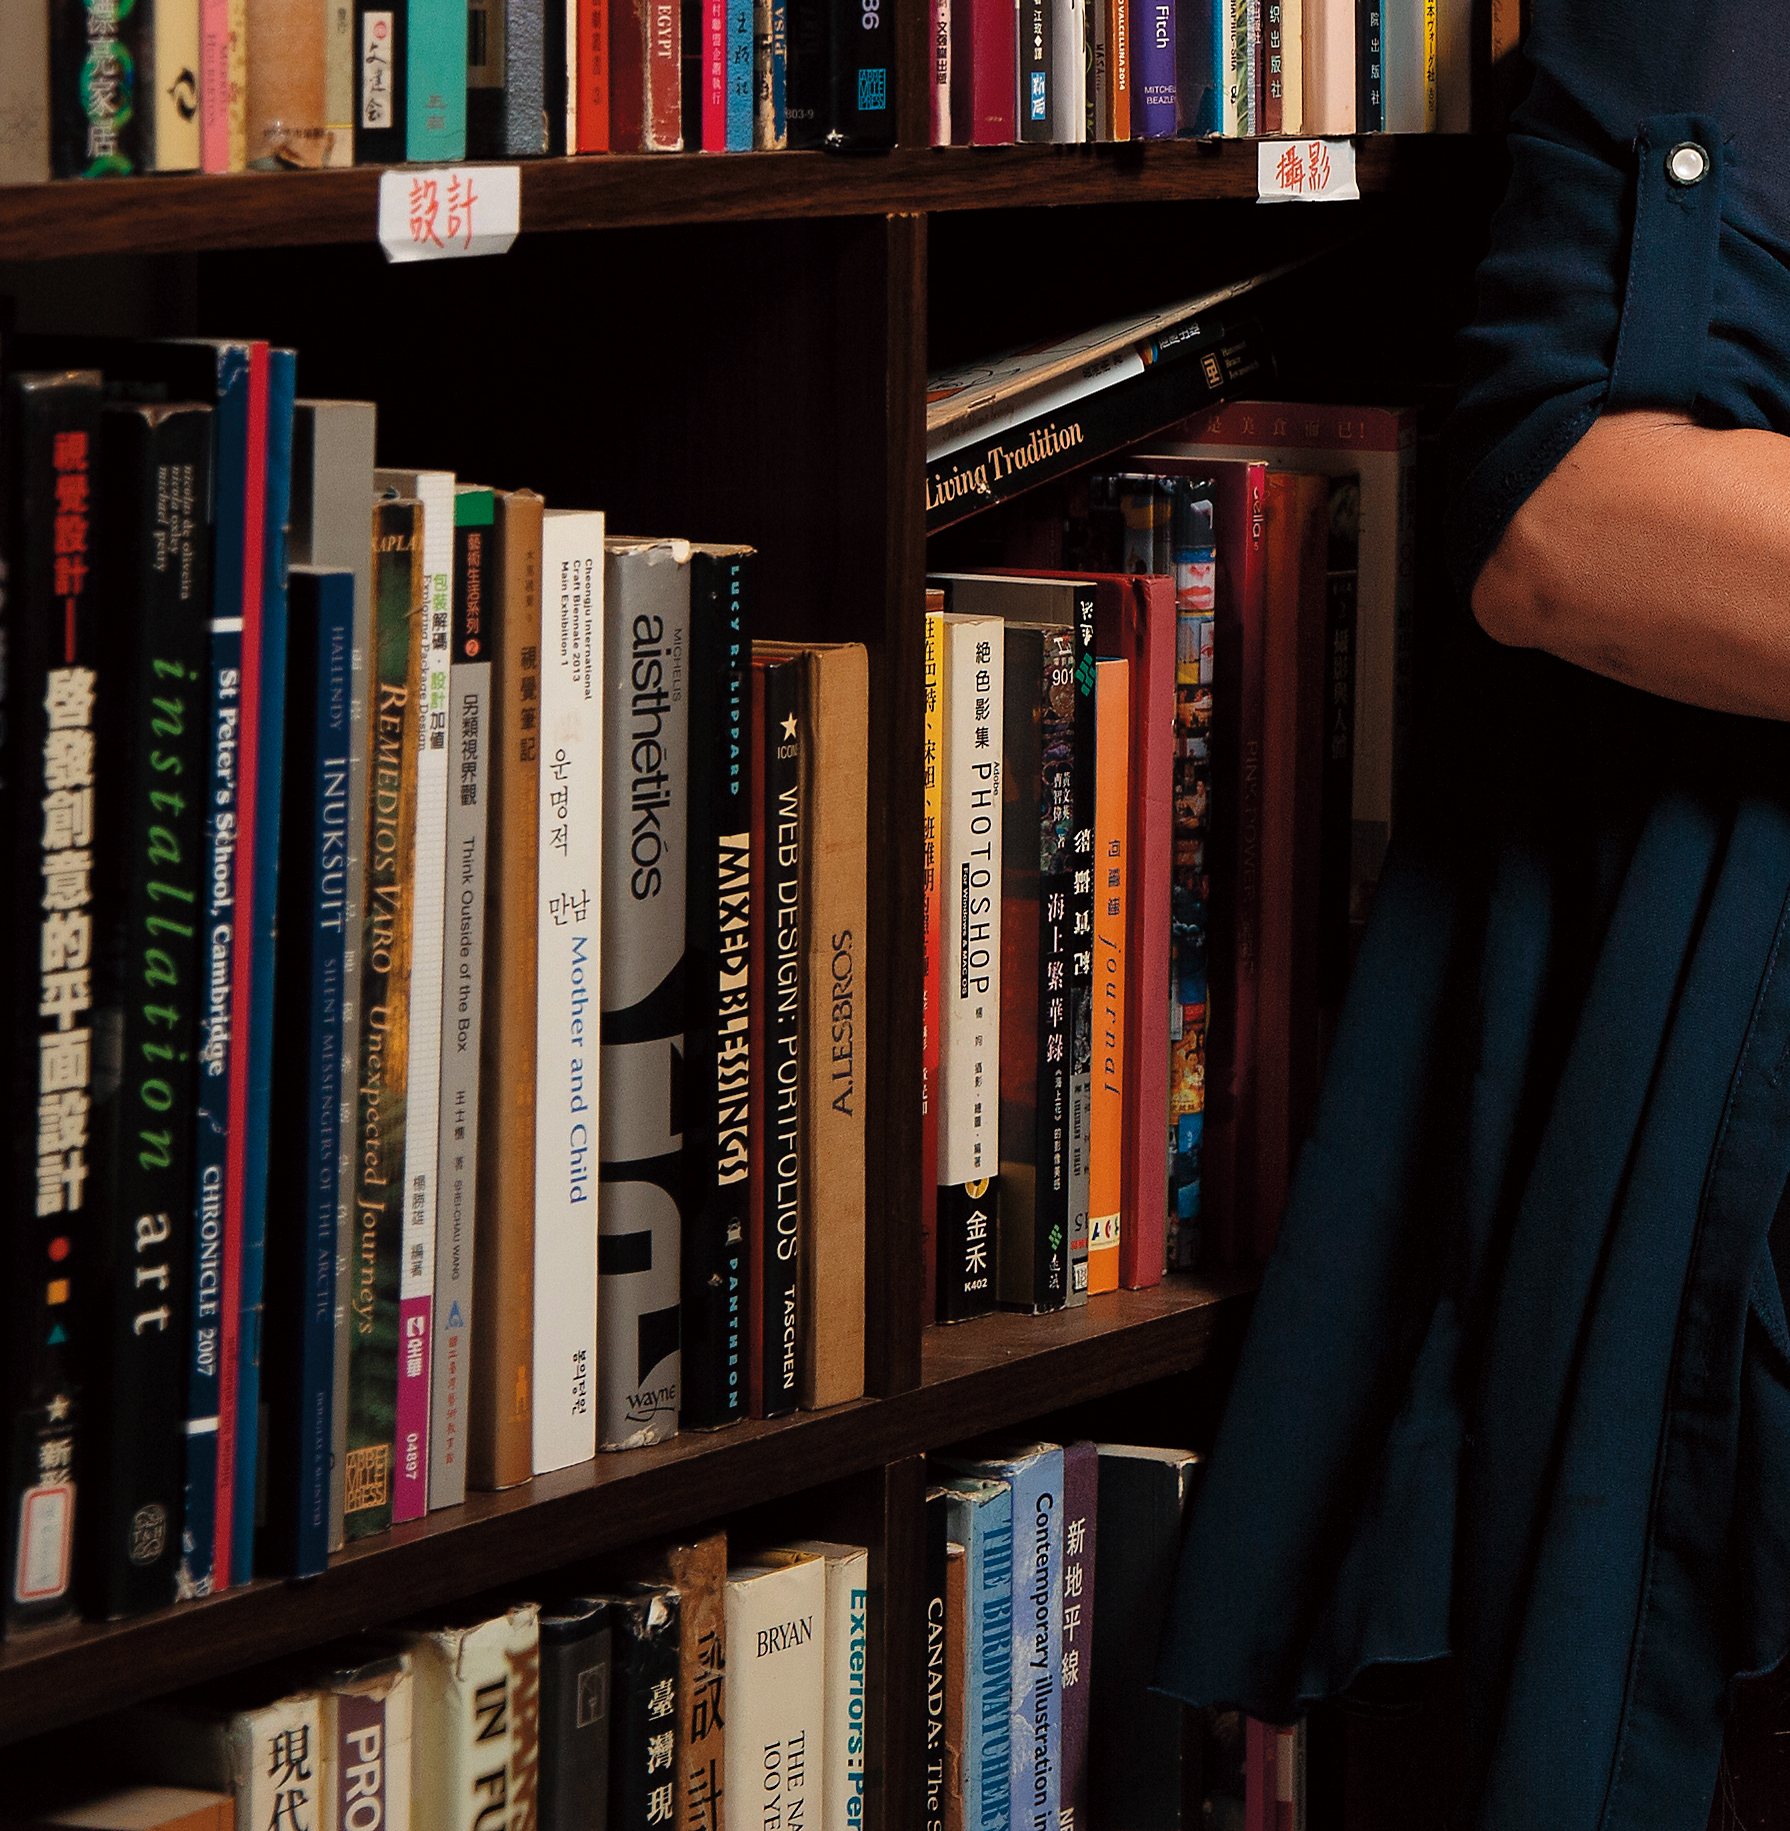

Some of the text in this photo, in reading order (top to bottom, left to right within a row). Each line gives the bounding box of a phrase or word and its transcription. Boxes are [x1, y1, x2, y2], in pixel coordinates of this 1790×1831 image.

[656, 5, 673, 59] EGYPT
[774, 6, 786, 57] PISA
[1117, 6, 1126, 67] VALCELLINA
[1155, 5, 1171, 50] Fitch
[409, 174, 479, 252] 設計
[1275, 142, 1332, 192] 攝影
[925, 420, 1085, 512] Living Tradition
[560, 560, 570, 654] Main Exhibition
[572, 559, 582, 683] Craft Biennale 2013
[583, 557, 594, 701] Cheongju International
[671, 627, 683, 702] MICHELIS
[729, 565, 740, 797] LUCY R. LIPPARD
[973, 641, 992, 750] 絕色影集
[320, 756, 347, 934] INUKSUIT
[374, 682, 408, 873] REMEDIOS
[548, 748, 573, 857] 운명적
[206, 669, 240, 1077] St Peter's Cambridge
[369, 884, 401, 975] VARO
[456, 835, 475, 1053] Think Outside of the Box
[968, 761, 1000, 994] PHOTOSHOP Adobe
[132, 658, 198, 1336] installation art
[775, 785, 800, 1262] WEB DESIGN: PORTFOLIOS
[1045, 892, 1065, 1063] 海上繁華錄
[1097, 933, 1122, 1096] journal
[358, 1004, 391, 1188] Unexpected
[569, 935, 590, 1205] Mother and Child
[196, 1165, 221, 1378] CHRONICLE 2007
[351, 1191, 388, 1335] Journeys
[963, 1277, 989, 1293] K402
[964, 1209, 988, 1275] 金禾
[727, 1256, 739, 1409] PANTHEON
[781, 1283, 797, 1391] TASCHEN
[404, 1432, 419, 1481] 04897
[756, 1615, 813, 1658] BRYAN
[1031, 1492, 1055, 1669] Contemporary
[1061, 1517, 1088, 1689] 新地平線
[926, 1596, 948, 1811] CANADA: The
